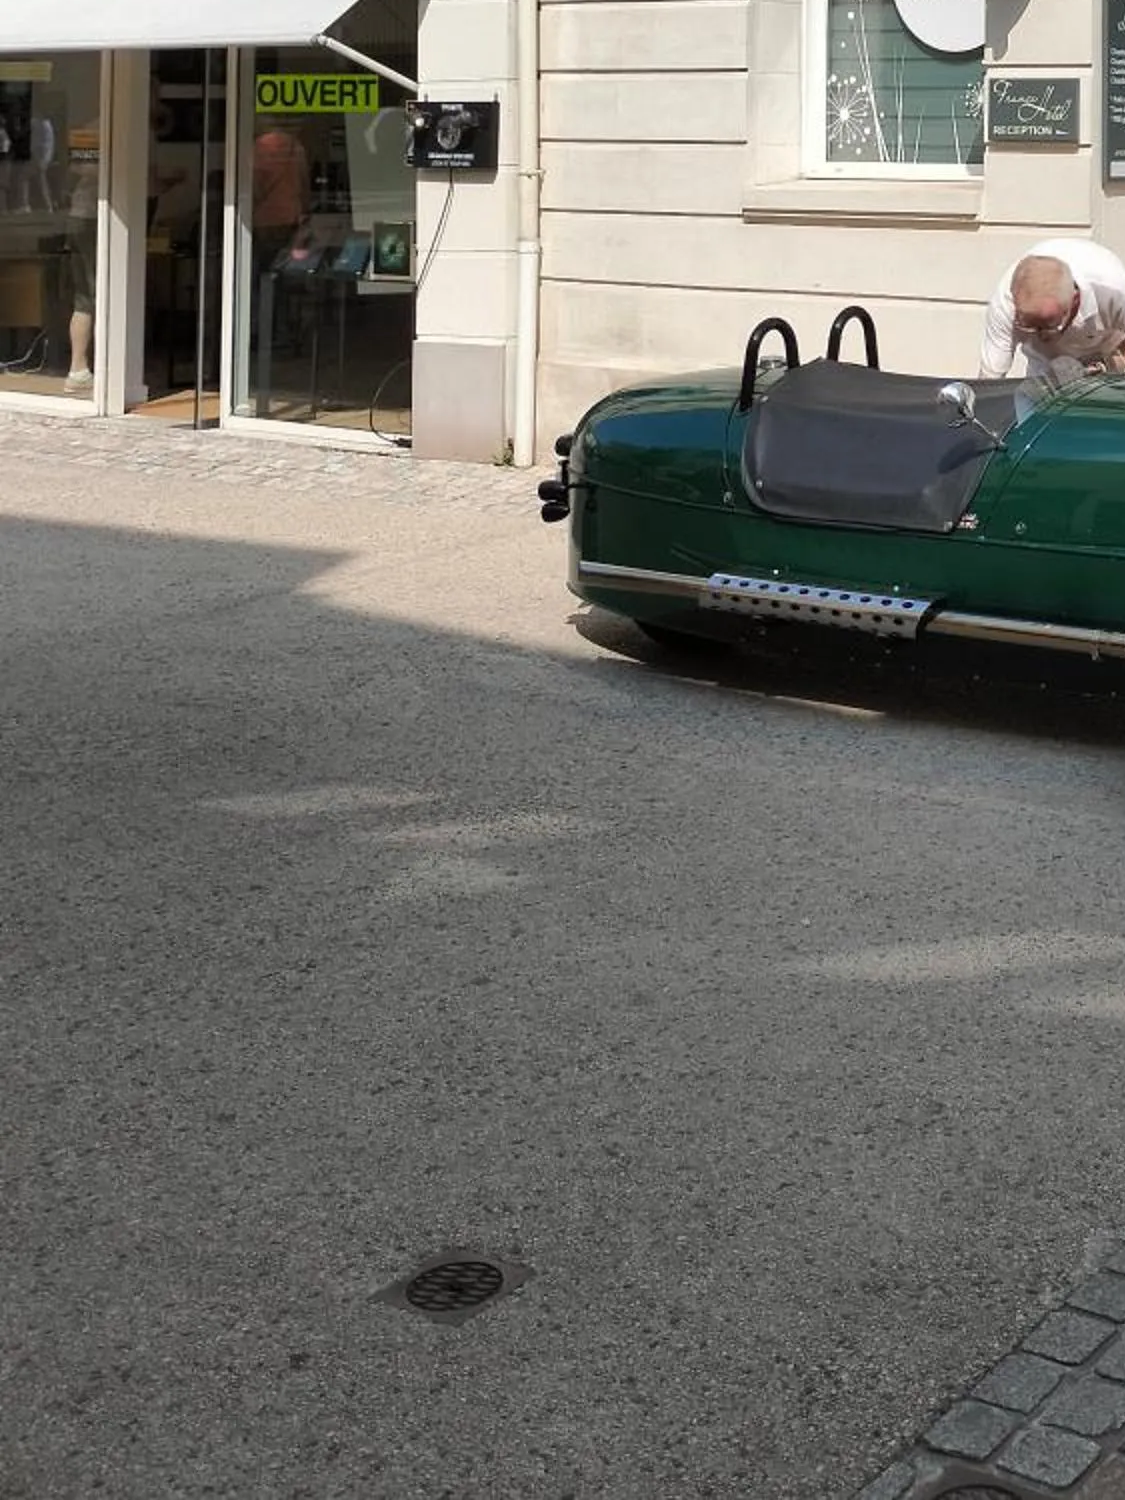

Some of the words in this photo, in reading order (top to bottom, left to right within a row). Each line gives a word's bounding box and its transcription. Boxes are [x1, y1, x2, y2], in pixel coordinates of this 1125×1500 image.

[257, 79, 377, 107] OUVERT
[993, 79, 1039, 104] France
[993, 125, 1053, 136] RECEPTION
